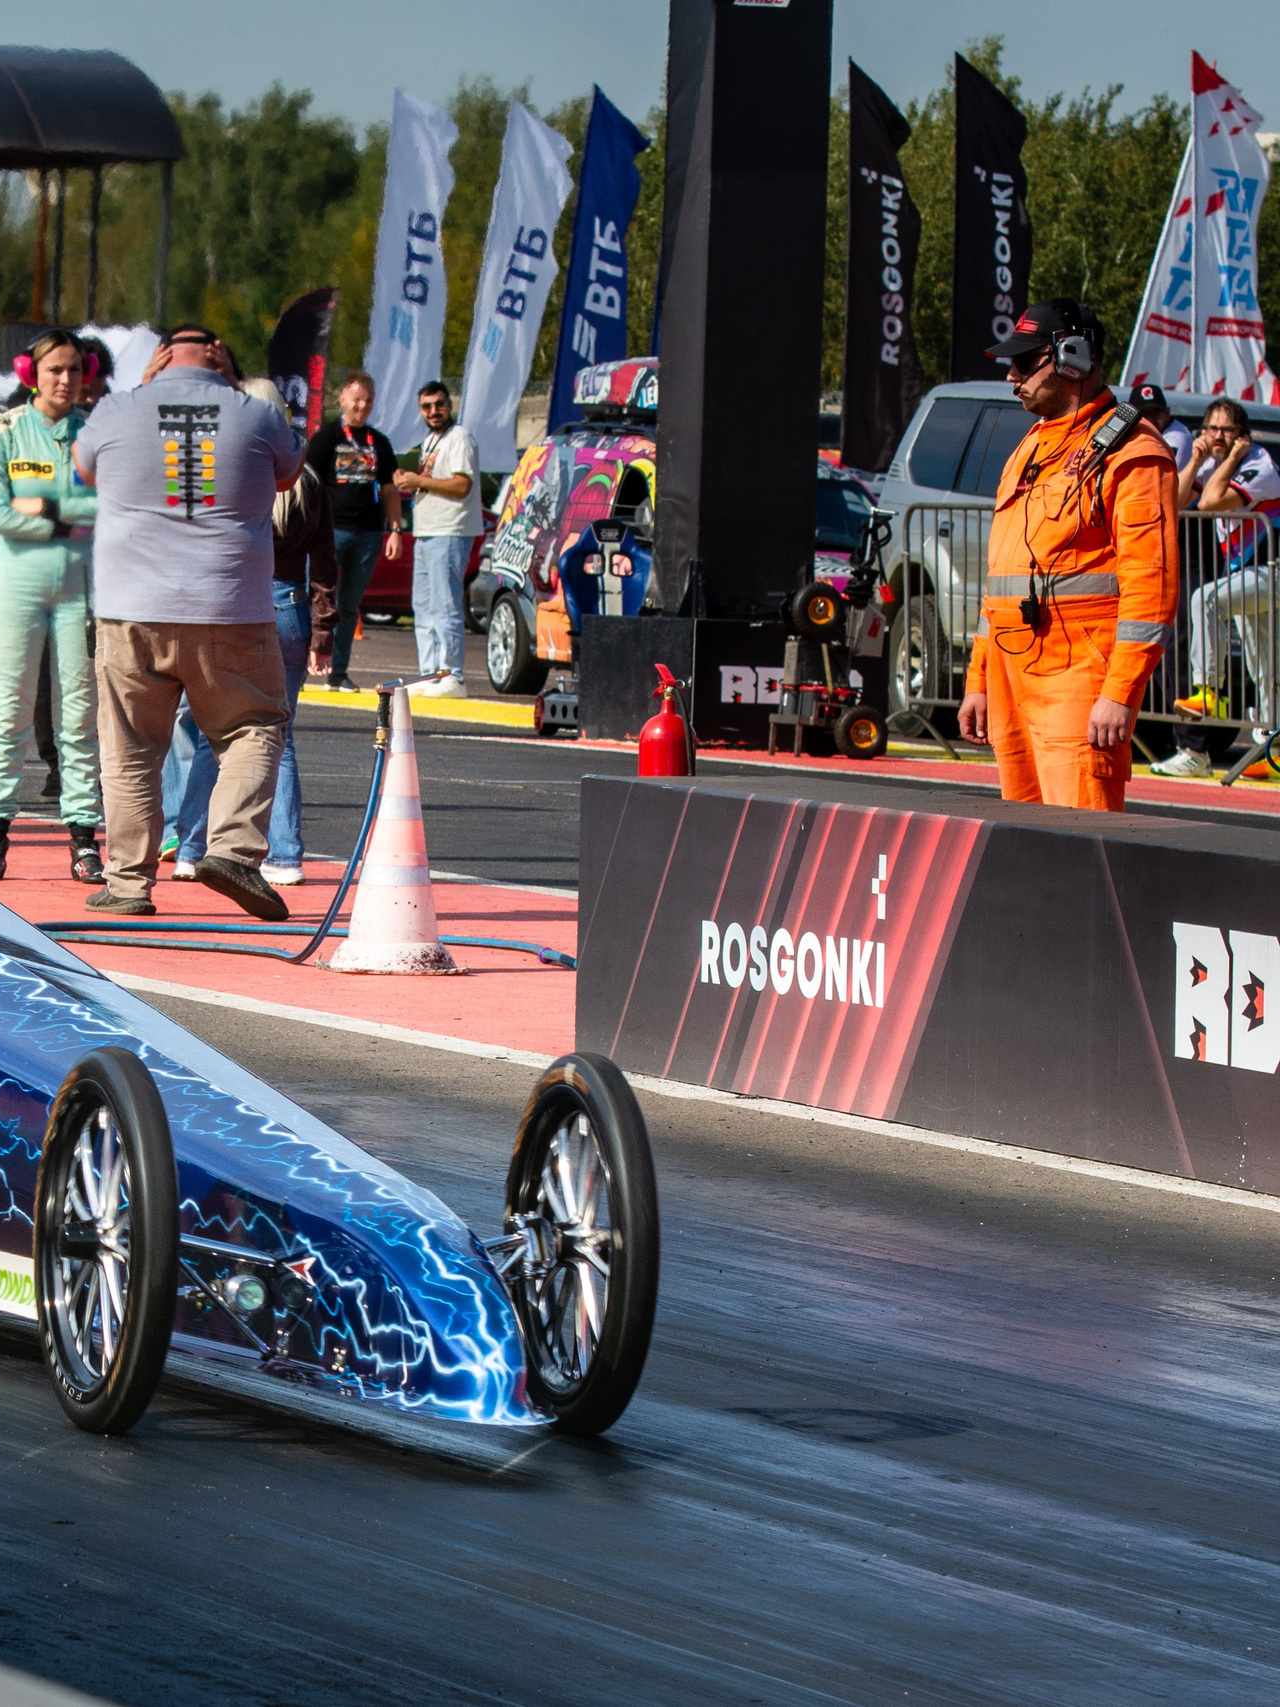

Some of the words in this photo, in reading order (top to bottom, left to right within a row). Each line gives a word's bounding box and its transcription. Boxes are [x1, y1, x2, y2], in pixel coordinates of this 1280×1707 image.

[495, 225, 548, 320] ВТБ
[584, 215, 623, 320] ВТБ
[880, 174, 904, 366] ROSGONKI
[701, 920, 886, 1008] ROSGONKI
